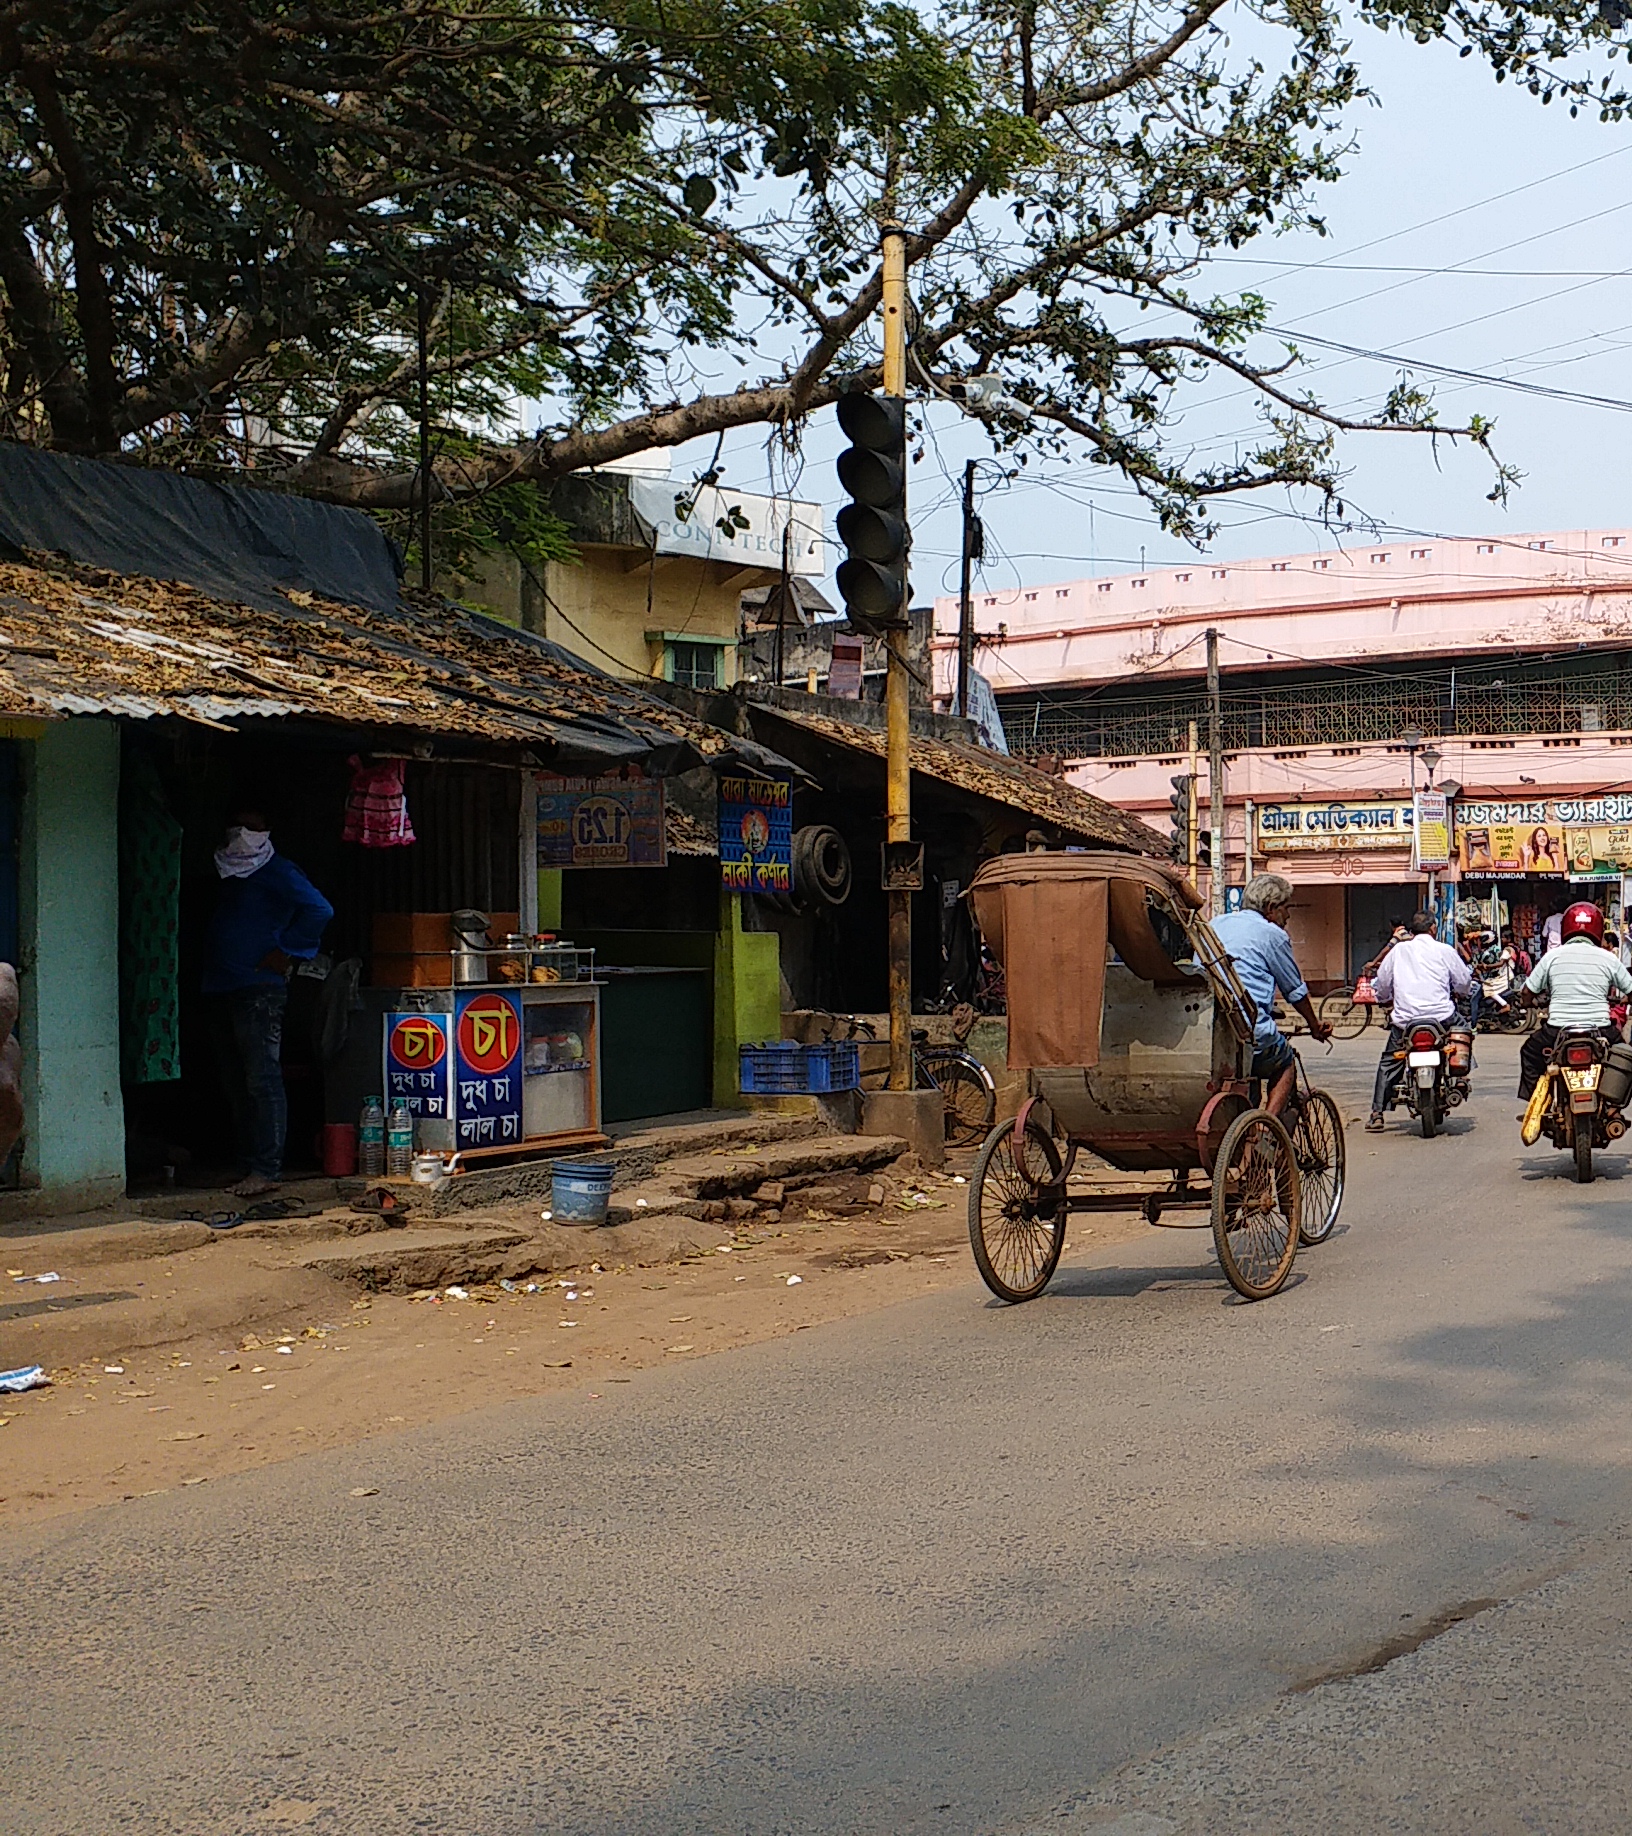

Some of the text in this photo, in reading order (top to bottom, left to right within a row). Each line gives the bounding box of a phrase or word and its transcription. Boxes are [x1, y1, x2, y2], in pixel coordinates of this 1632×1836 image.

[720, 776, 746, 803] বাবা
[1306, 803, 1397, 831] মেডিক্যাল
[1455, 801, 1547, 826] মজুমদার
[720, 852, 754, 888] লাকী
[1465, 871, 1527, 880] DEBU MAJUMDAR
[398, 1022, 438, 1062] চা
[465, 1001, 513, 1060] চা
[391, 1071, 437, 1092] দুধ চা
[459, 1074, 511, 1112] দুধ চা
[427, 1095, 445, 1115] চা
[459, 1110, 520, 1144] লাল চা
